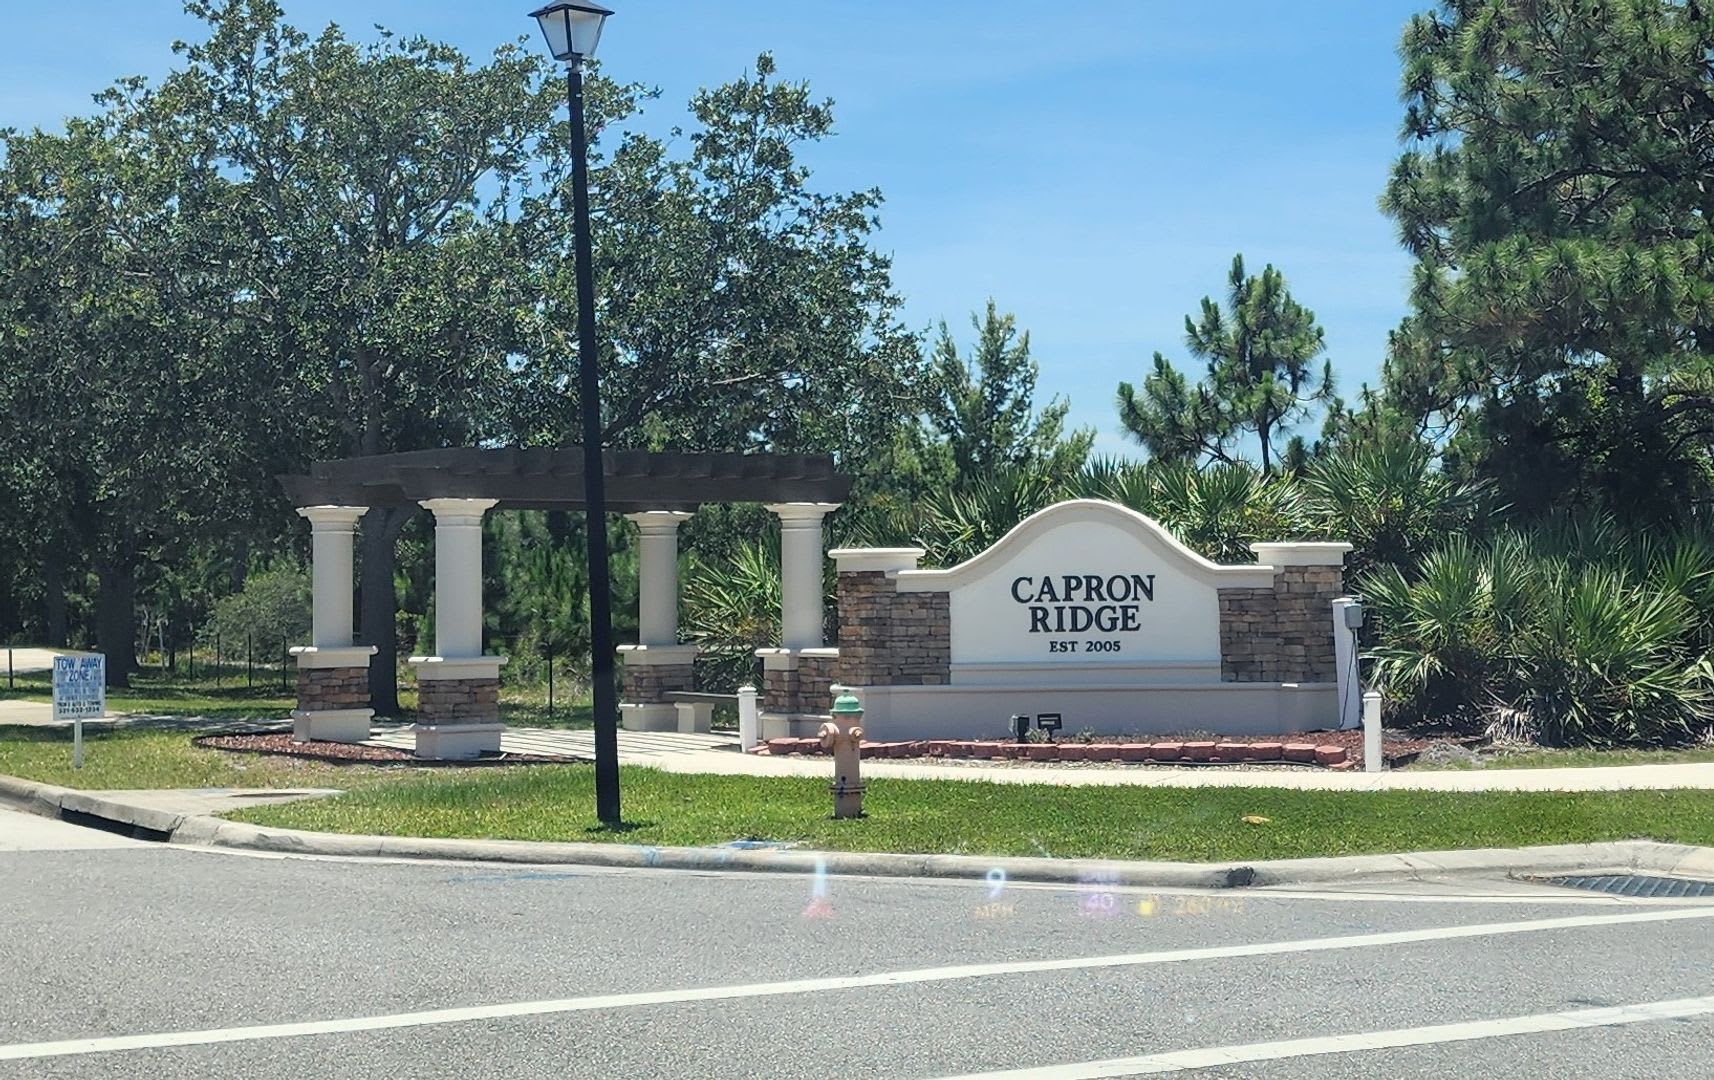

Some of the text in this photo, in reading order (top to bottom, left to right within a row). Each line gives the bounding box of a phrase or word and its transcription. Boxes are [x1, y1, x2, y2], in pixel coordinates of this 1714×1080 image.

[1011, 575, 1155, 603] CAPRON
[1029, 605, 1141, 632] RIDGE
[1050, 641, 1121, 652] EST 2005
[56, 657, 102, 670] TOW AWAY
[69, 670, 90, 682] ZONE
